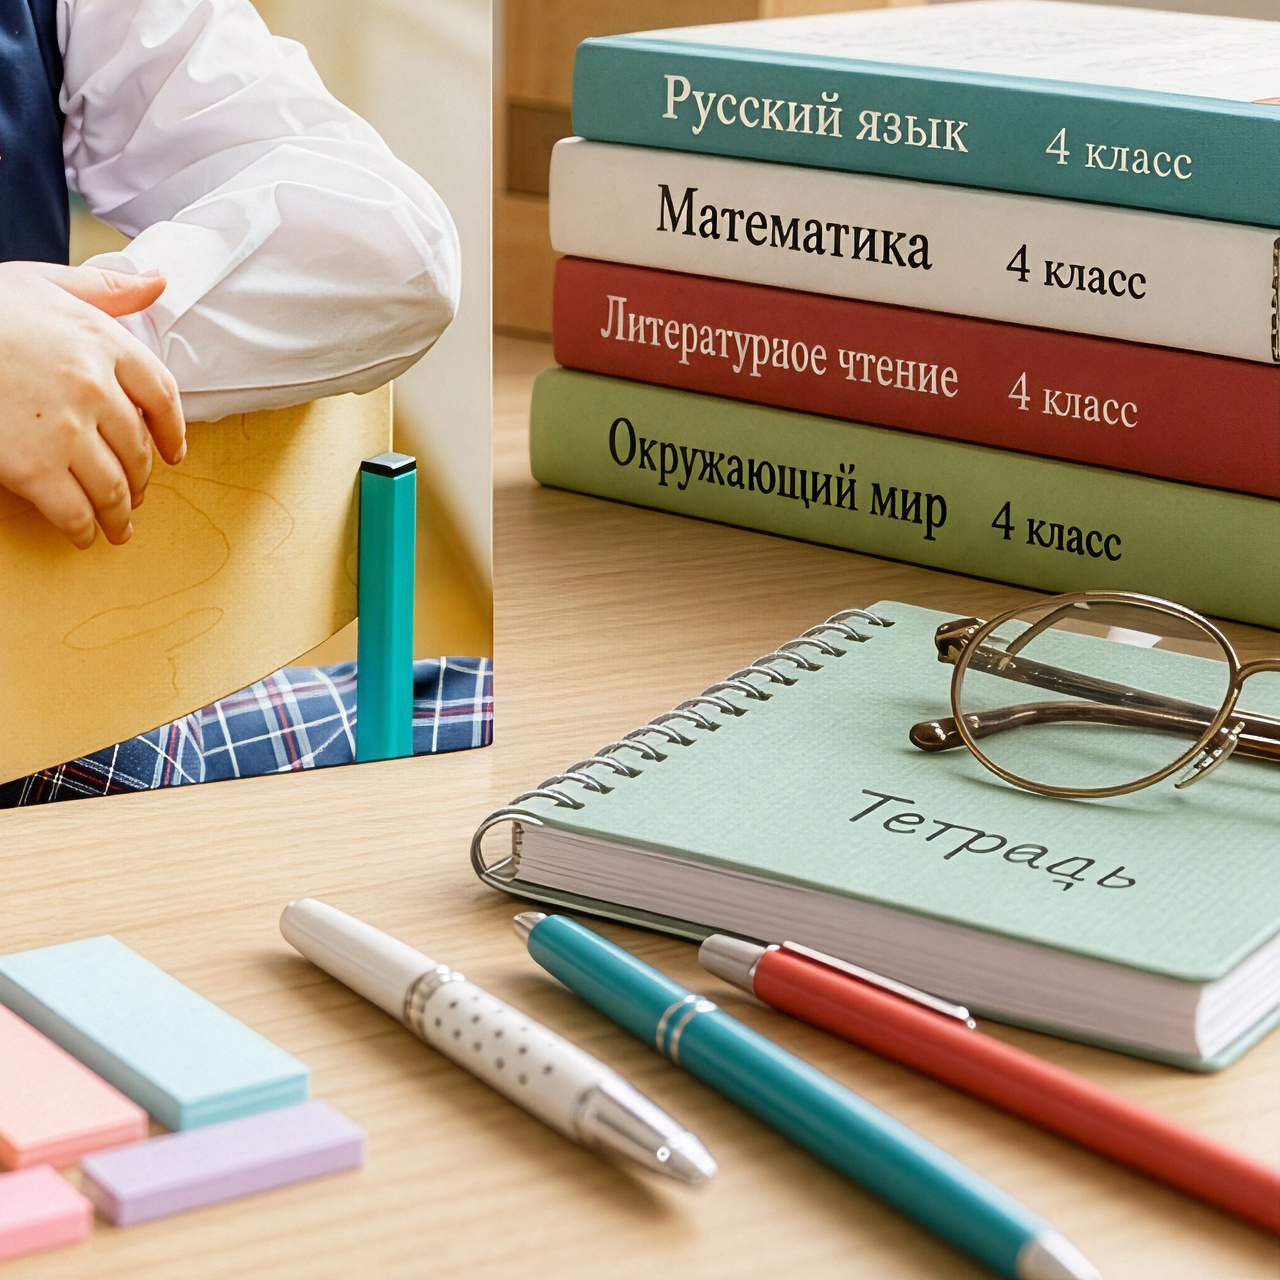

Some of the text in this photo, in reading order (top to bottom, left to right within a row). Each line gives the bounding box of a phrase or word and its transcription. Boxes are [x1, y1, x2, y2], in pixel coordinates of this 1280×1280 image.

[662, 74, 1194, 181] Русский язык 4 класс
[656, 183, 1148, 301] Математика 4 класс
[837, 348, 960, 399] чтение
[1007, 371, 1032, 412] 4
[1041, 388, 1139, 429] класс
[607, 416, 1123, 563] Окружающий мир 4 класс
[847, 787, 1138, 893] Тетрадь
